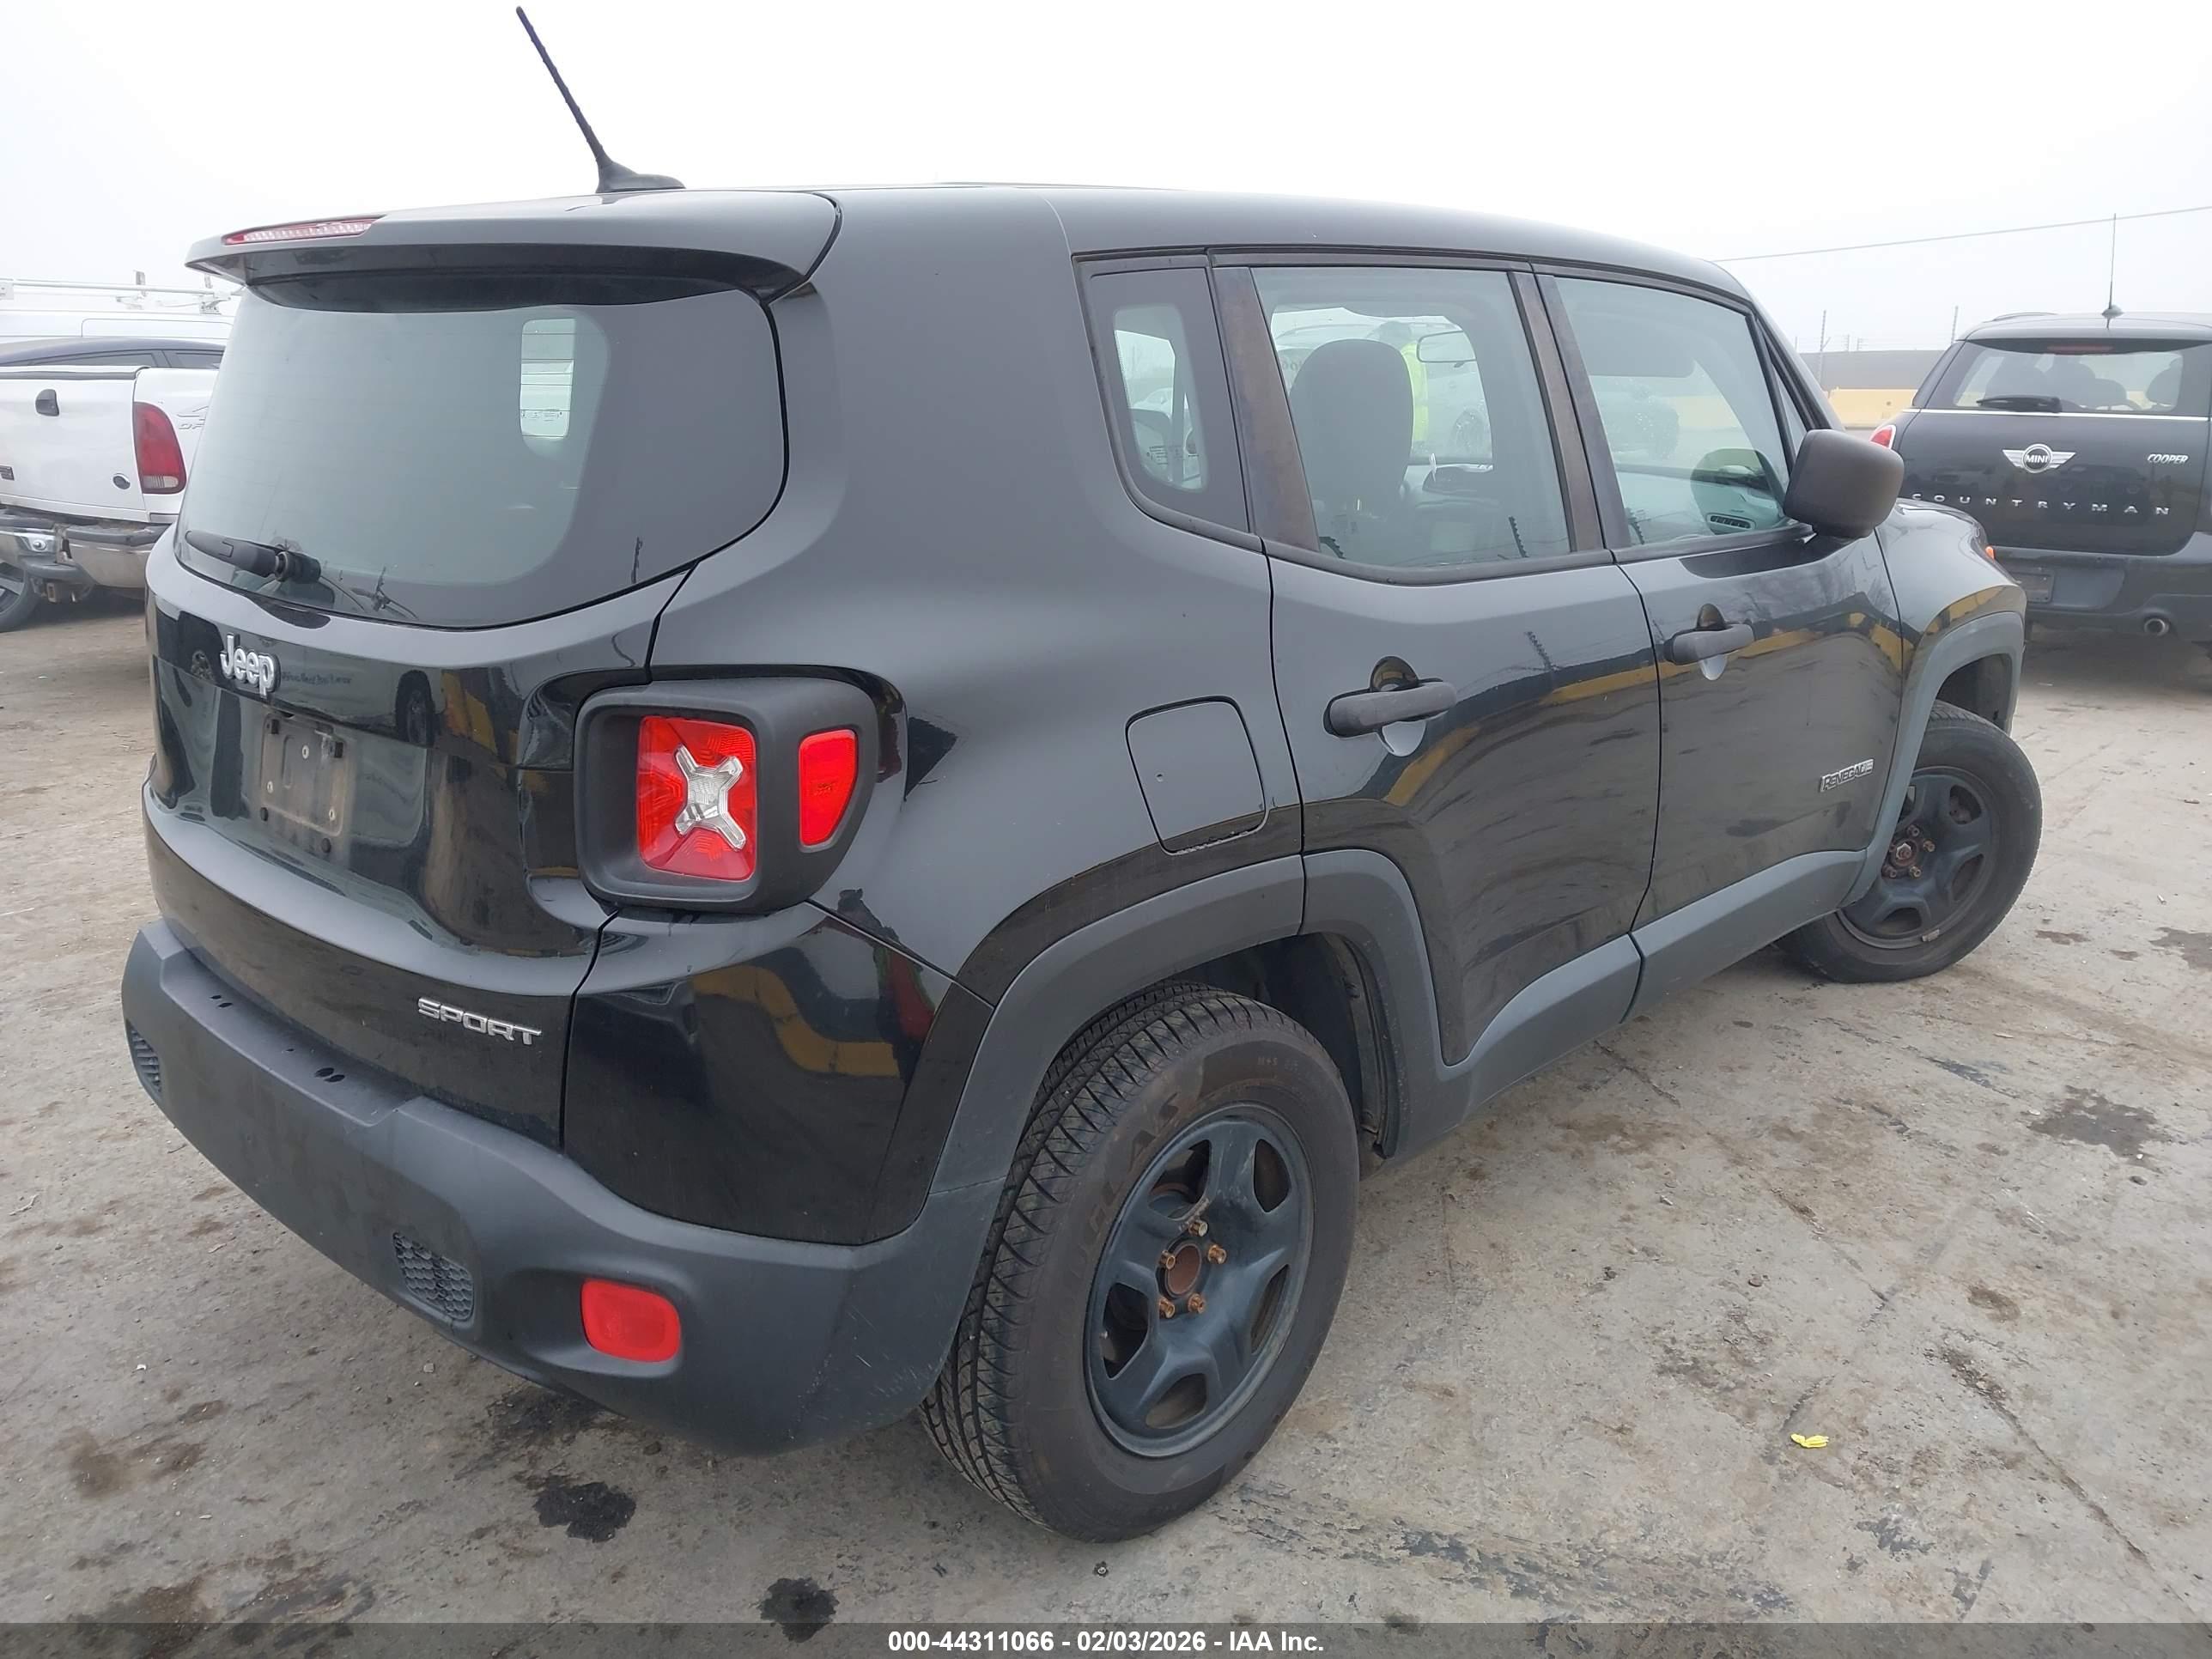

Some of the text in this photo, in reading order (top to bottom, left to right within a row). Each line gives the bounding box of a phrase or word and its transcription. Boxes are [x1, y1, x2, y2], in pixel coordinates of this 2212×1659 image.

[2026, 454, 2049, 464] MINI
[2148, 453, 2189, 464] COOPER
[1911, 493, 2170, 515] COUNTRYMAN
[220, 633, 275, 696] Jeep
[418, 998, 542, 1045] SPORT
